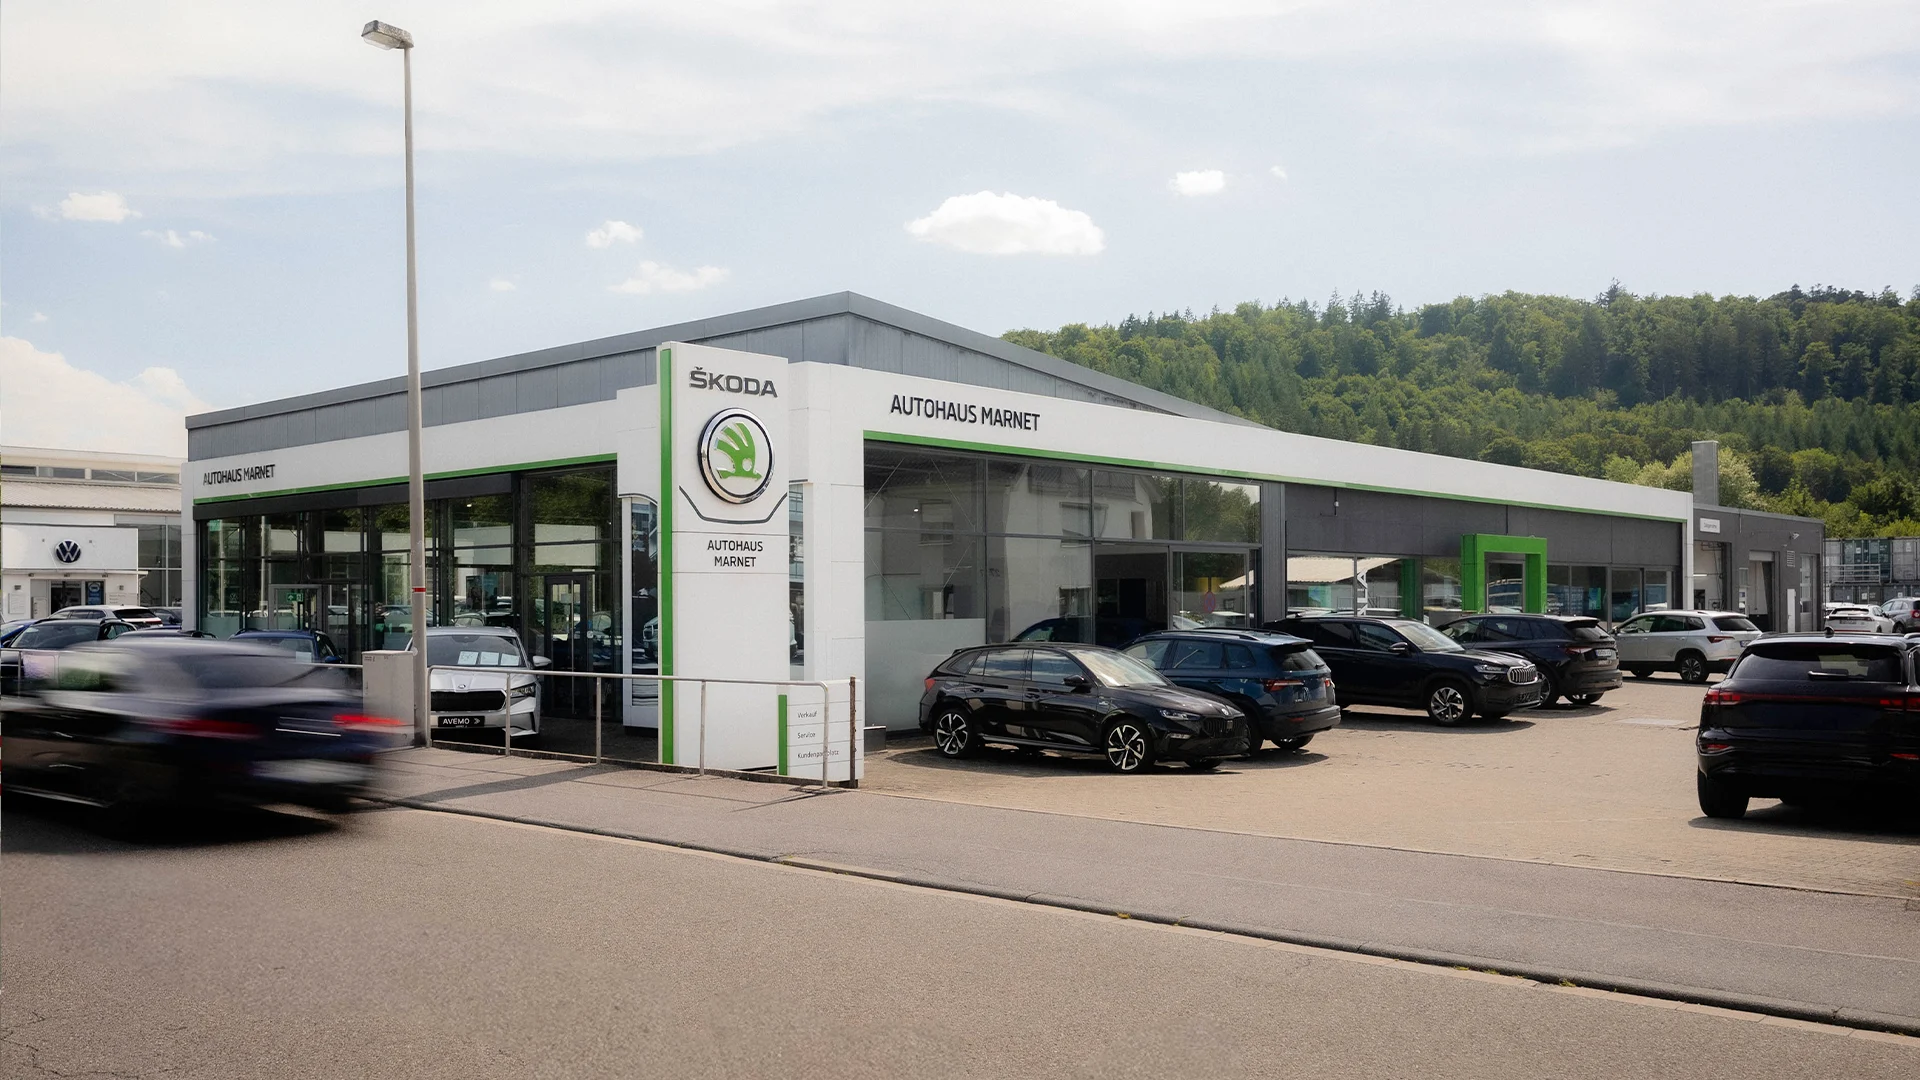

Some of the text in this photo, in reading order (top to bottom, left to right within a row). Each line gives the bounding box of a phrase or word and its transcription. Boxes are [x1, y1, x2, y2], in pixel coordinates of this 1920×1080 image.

[689, 366, 778, 398] ŠKODA
[890, 394, 1041, 431] AUTOHAUS MARNET
[203, 464, 275, 485] AUTOHAUS MARNET
[707, 539, 763, 552] AUTOHAUS
[714, 555, 757, 567] MARNET
[797, 710, 818, 718] Verkauf
[442, 717, 470, 725] AVEMO
[797, 731, 816, 739] Service
